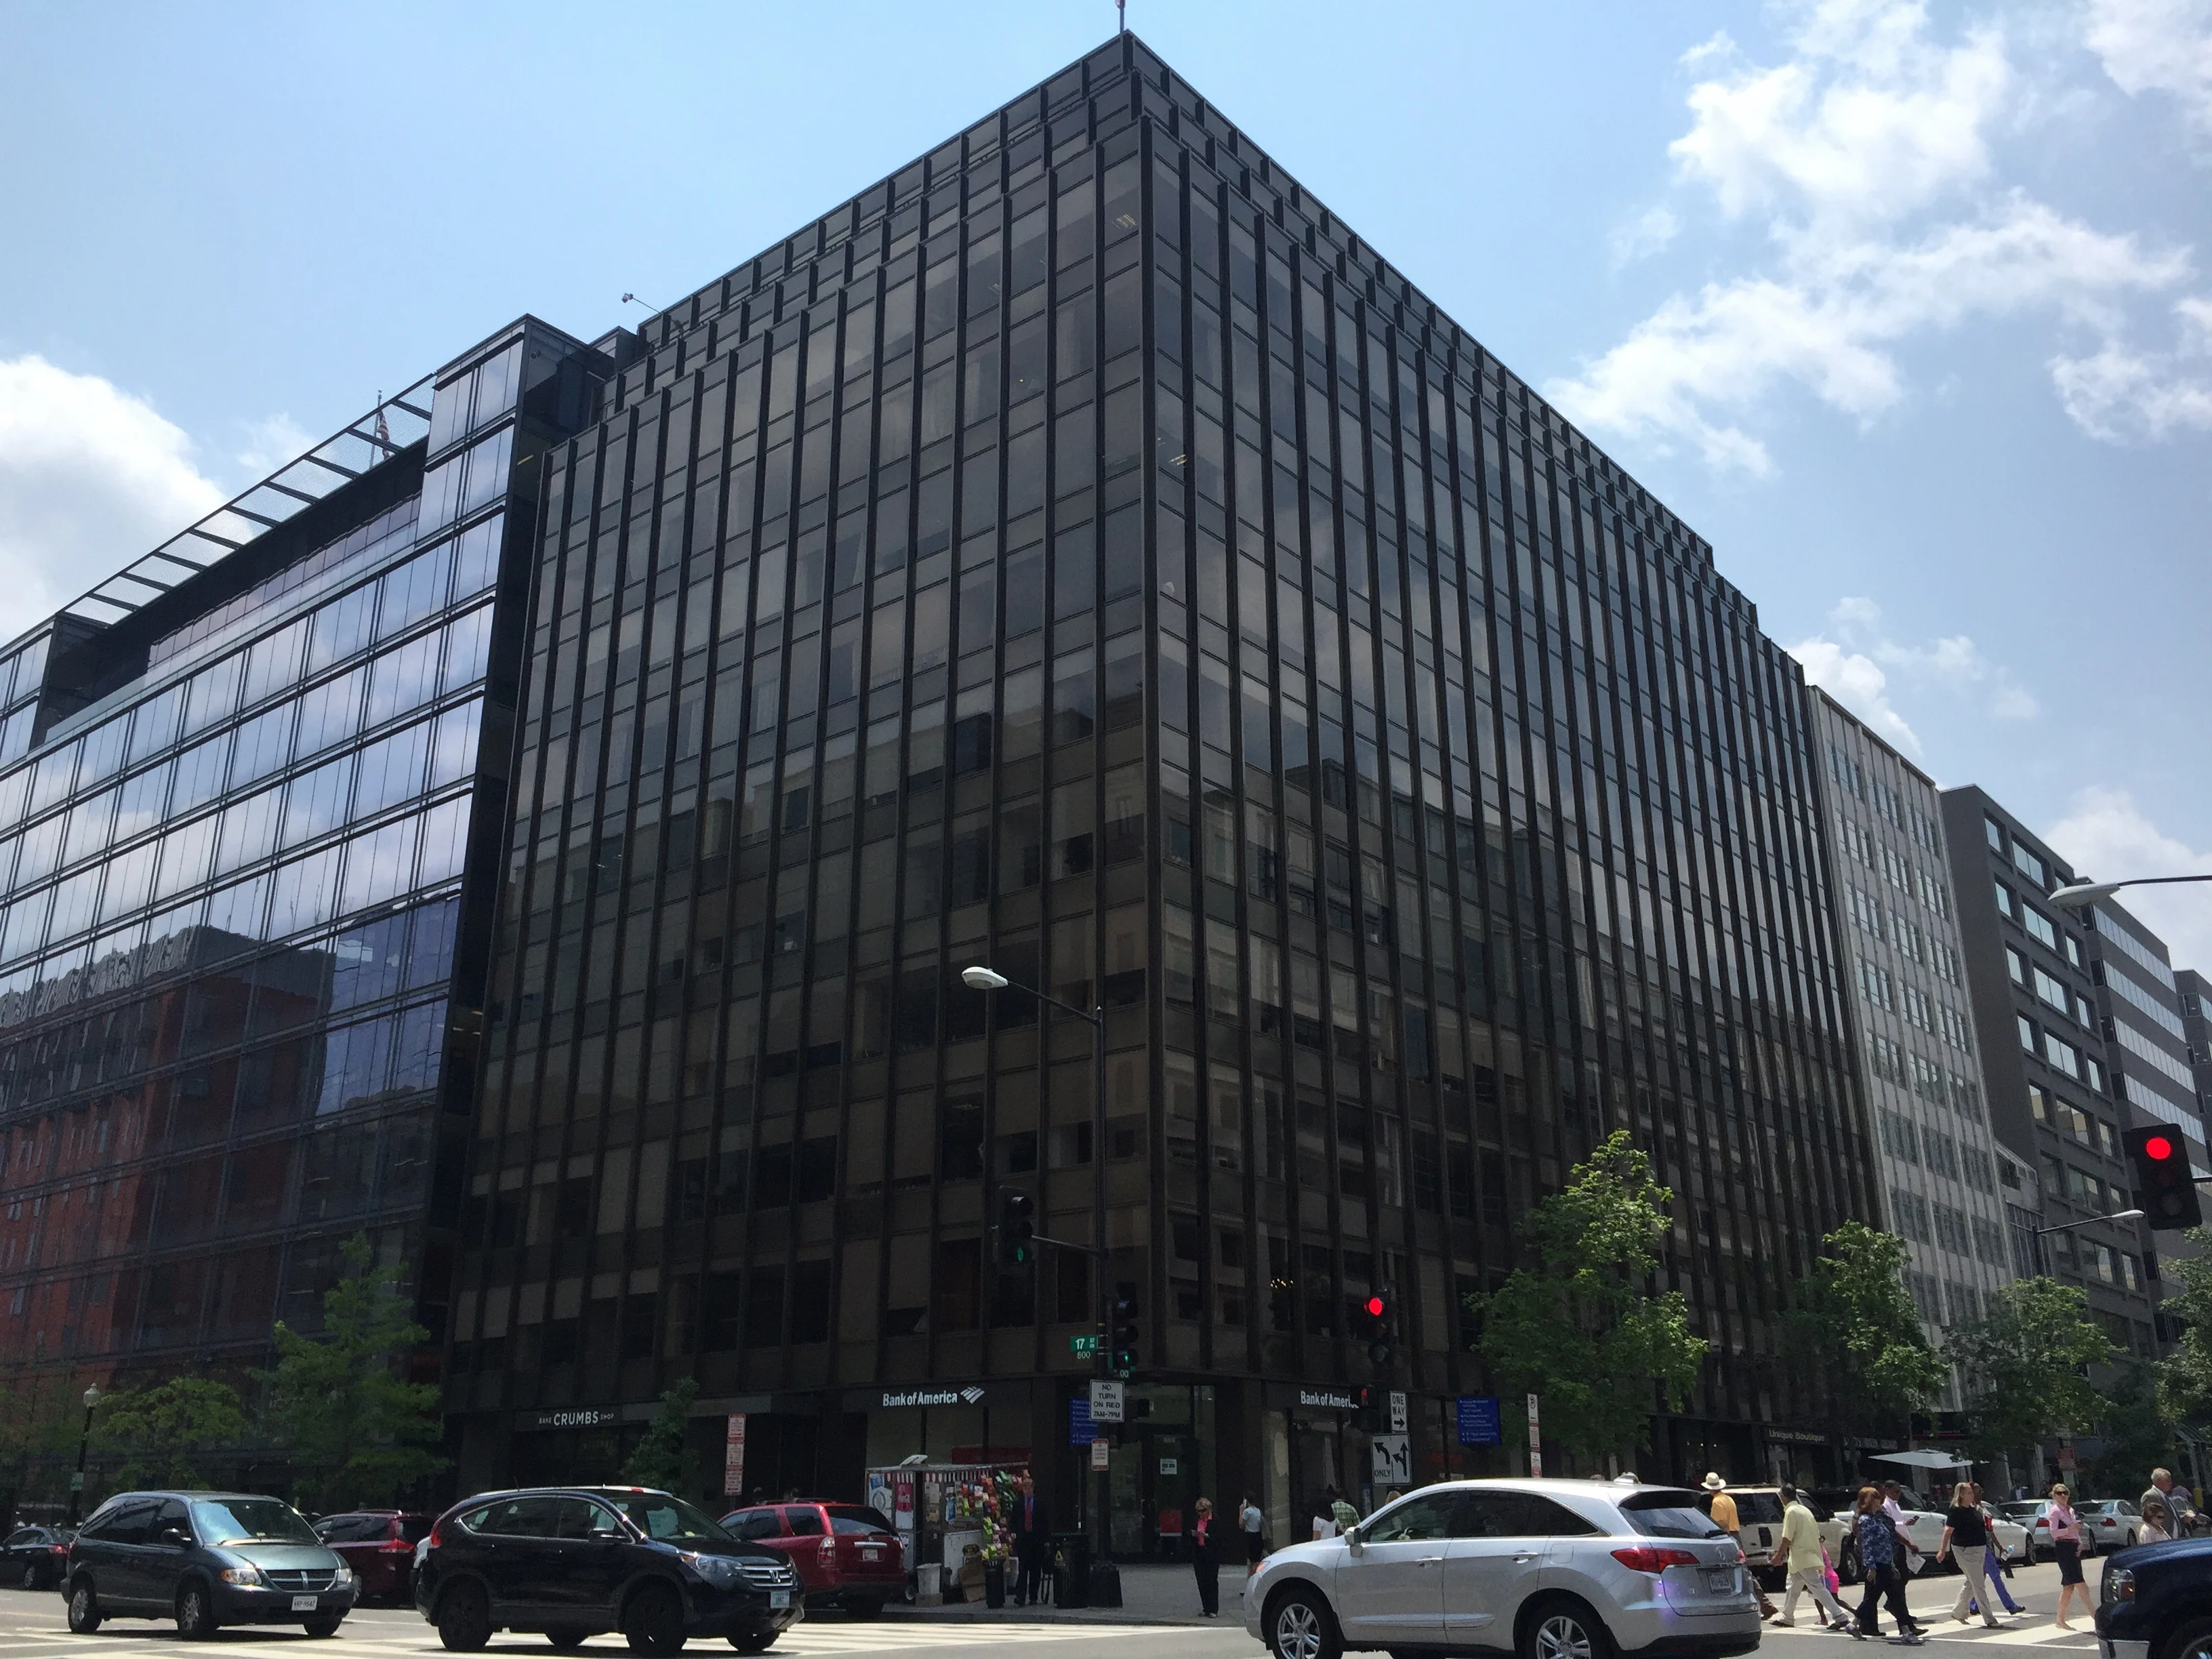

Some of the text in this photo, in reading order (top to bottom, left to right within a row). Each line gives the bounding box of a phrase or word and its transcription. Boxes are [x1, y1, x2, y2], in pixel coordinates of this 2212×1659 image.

[1075, 1337, 1085, 1350] 17
[1076, 1351, 1091, 1359] 800
[883, 1390, 958, 1406] Bank of America
[1300, 1391, 1359, 1408] Bank of Ameri
[1392, 1395, 1404, 1405] ONE
[1392, 1406, 1405, 1416] WAY
[553, 1411, 598, 1426] CRUMBS
[600, 1412, 615, 1420] SHOP
[1769, 1429, 1825, 1443] Unique Boutique
[1374, 1469, 1391, 1478] ONLY
